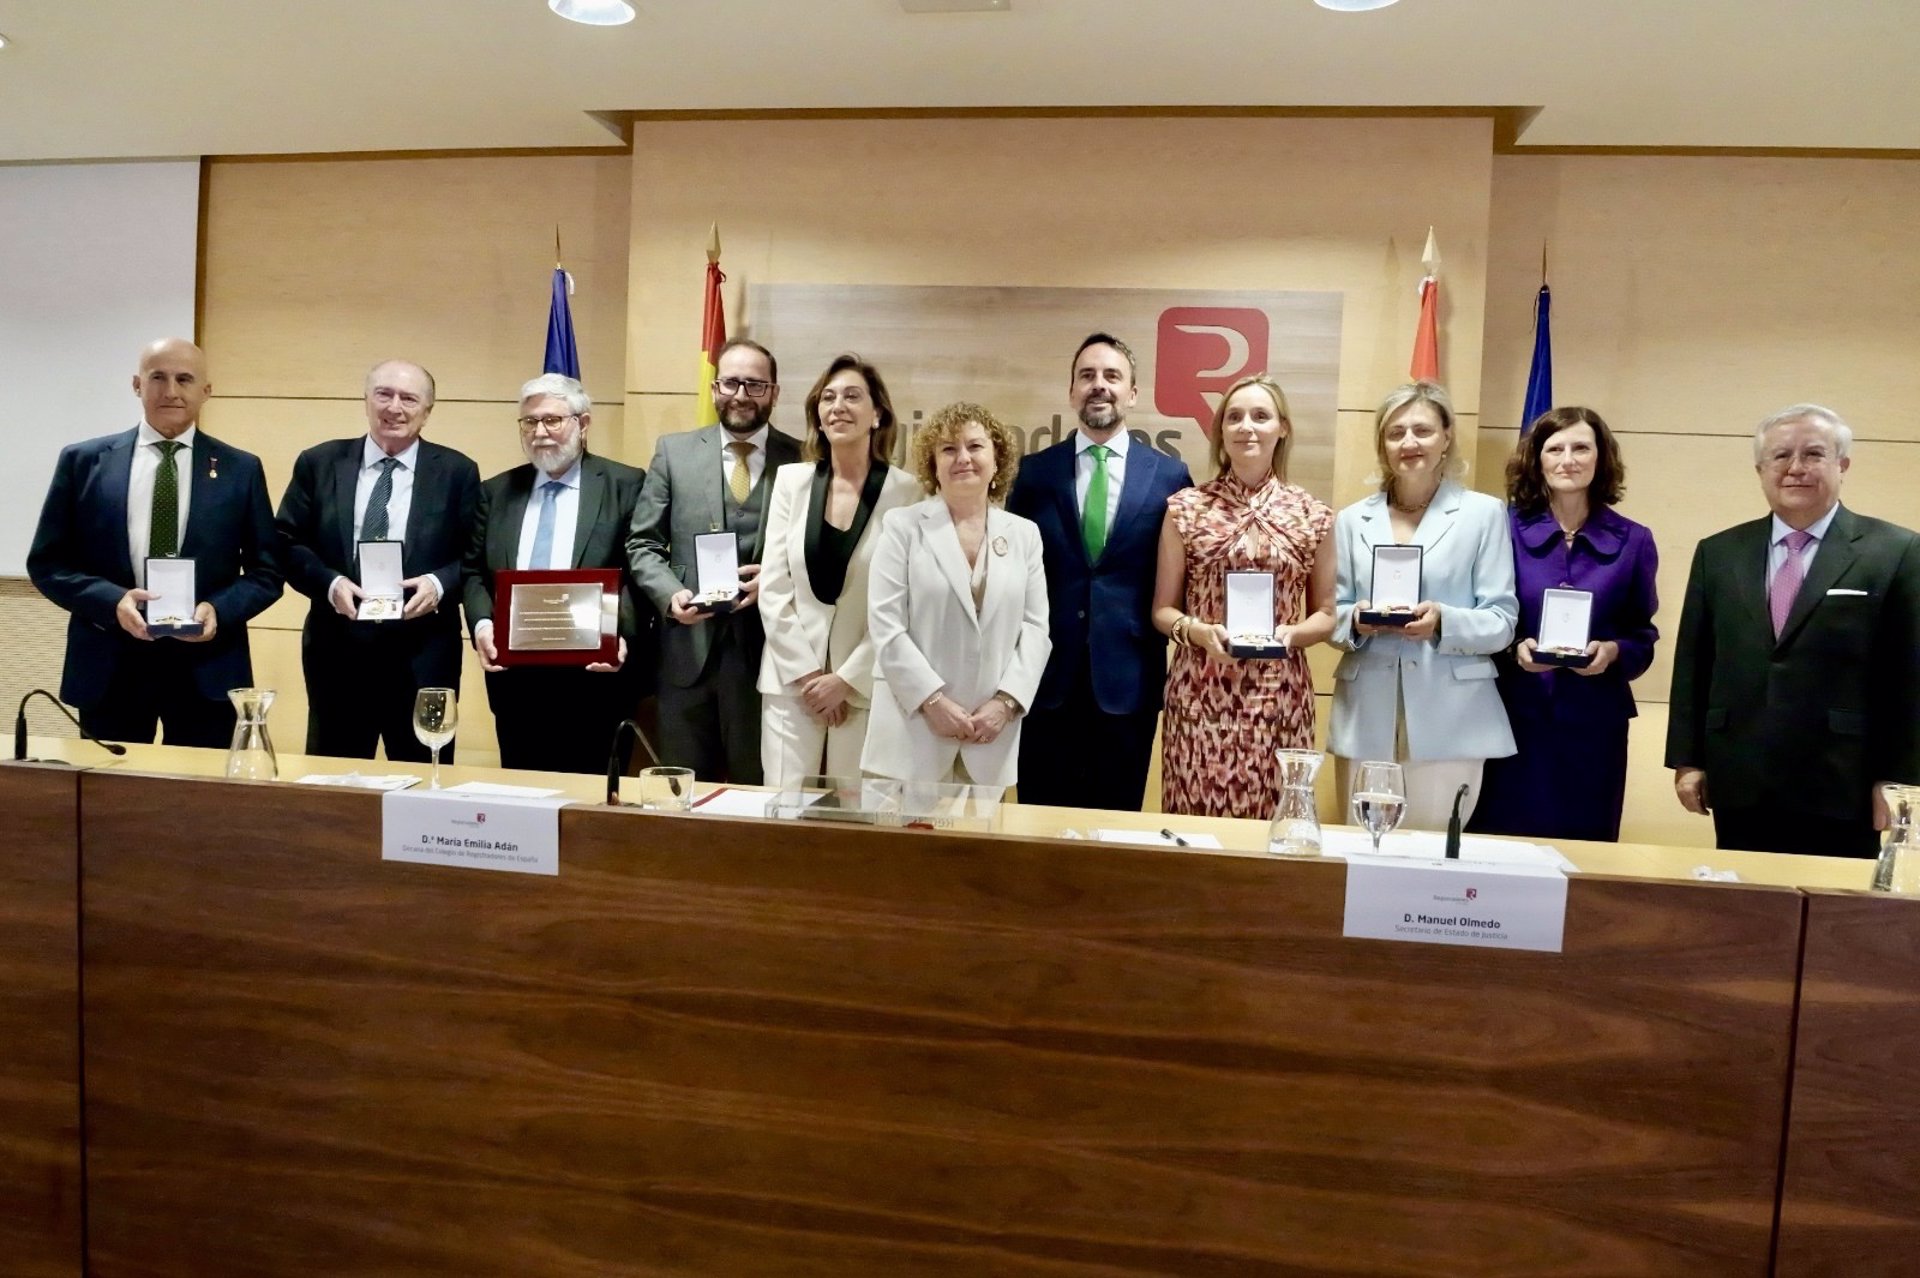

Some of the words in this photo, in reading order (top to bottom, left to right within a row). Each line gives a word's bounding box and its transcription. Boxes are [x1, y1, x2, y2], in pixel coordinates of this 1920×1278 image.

[464, 839, 492, 850] Emilia
[1404, 913, 1415, 923] D.
[1418, 915, 1457, 926] Manuel
[1460, 917, 1501, 929] Olmedo
[1395, 925, 1431, 935] Secretario
[1433, 927, 1442, 935] de
[1444, 929, 1470, 938] Estado
[1471, 931, 1481, 939] de
